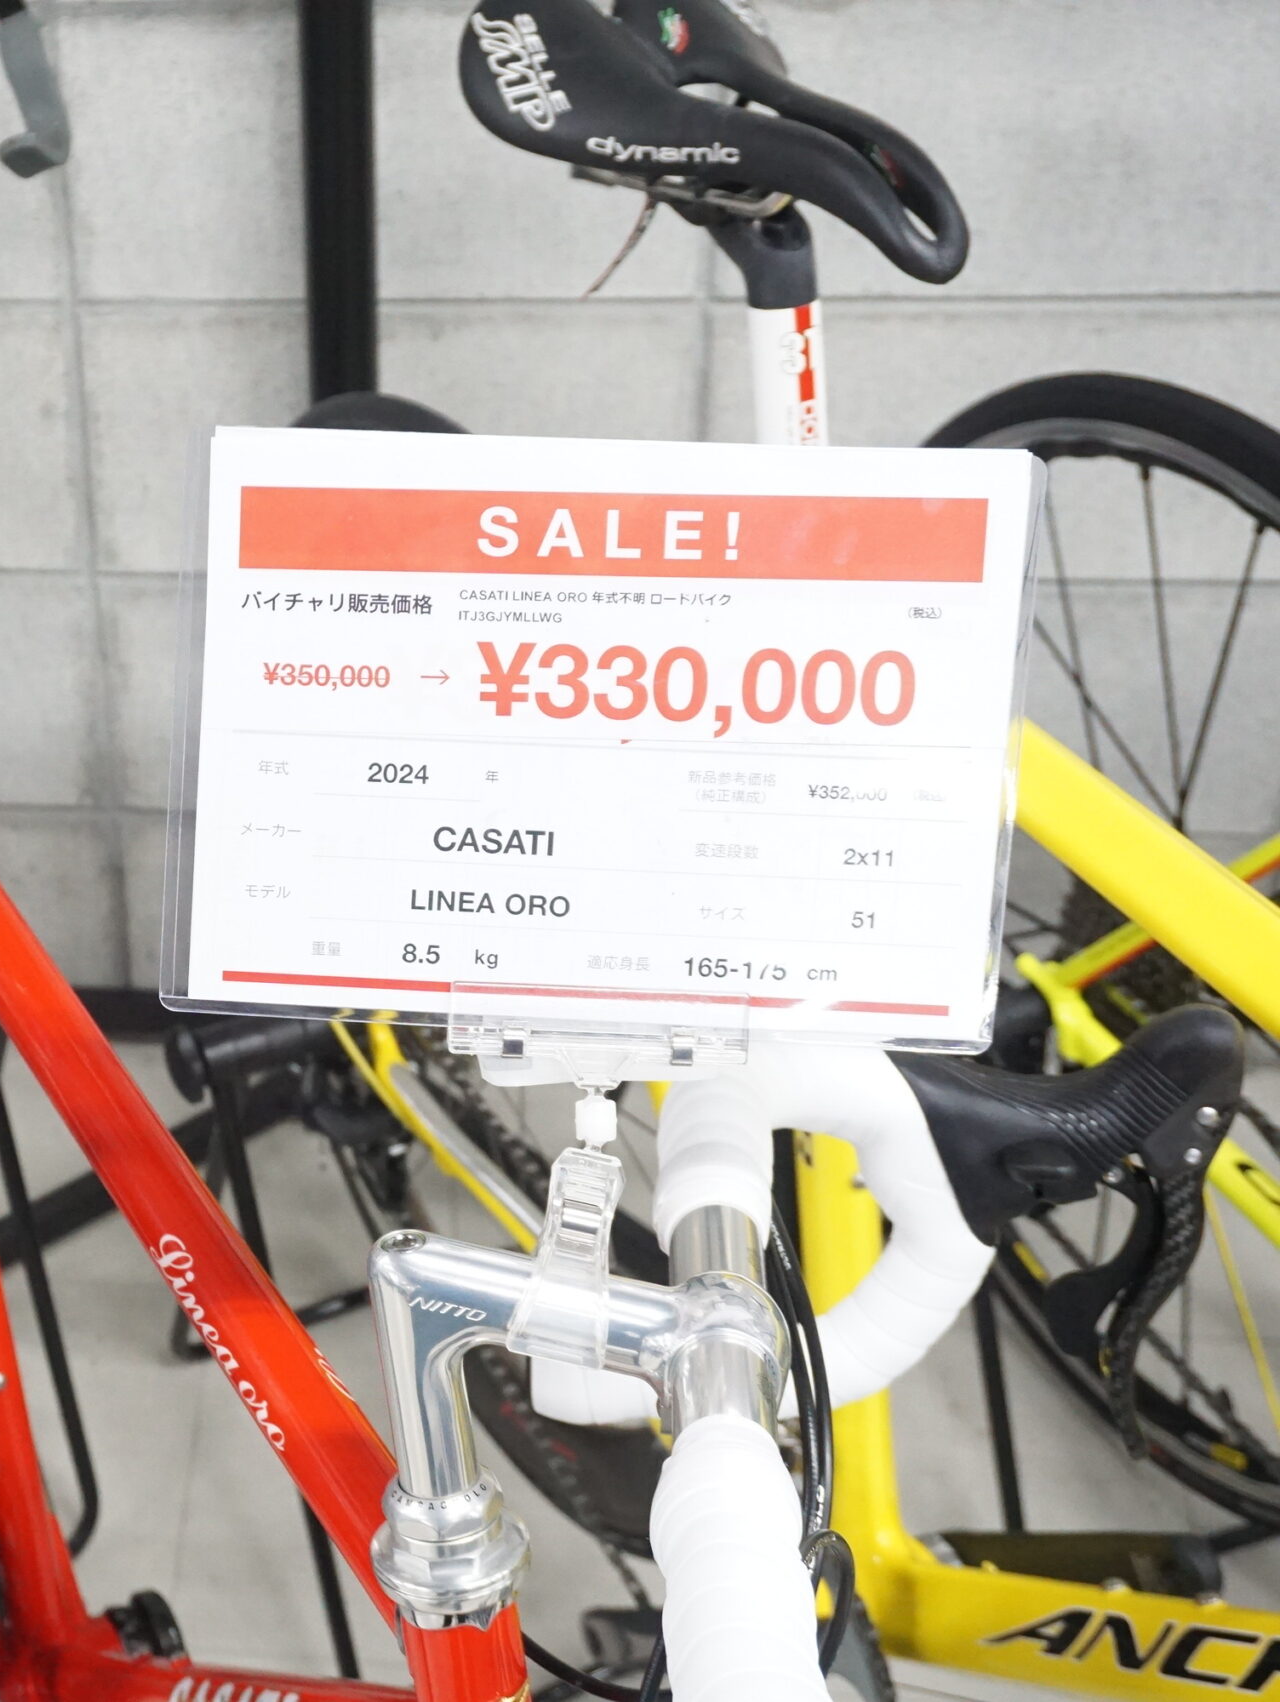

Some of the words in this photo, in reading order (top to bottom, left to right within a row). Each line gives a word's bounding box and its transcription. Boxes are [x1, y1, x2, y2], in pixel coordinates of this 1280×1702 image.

[513, 13, 572, 114] SELLE
[586, 135, 741, 165] dynamic
[477, 506, 742, 561] SALE!
[241, 590, 433, 616] バイチャリ販売価格
[458, 589, 509, 602] CASATI
[511, 590, 552, 602] LINEA
[556, 591, 588, 603] ORO
[591, 591, 646, 605] 年式不明
[650, 592, 732, 606] ロードバイク
[263, 661, 391, 691] ¥350,000
[476, 640, 917, 738] ¥330,000
[258, 759, 289, 776] 年式
[367, 763, 429, 785] 2024
[485, 770, 499, 784] 年
[240, 822, 302, 839] メーカー
[433, 826, 555, 857] CASATI
[843, 848, 895, 868] 2x11
[245, 884, 291, 900] モデル
[410, 889, 496, 914] LINEA
[505, 893, 571, 918] ORO
[851, 911, 877, 930] 51
[402, 943, 441, 965] 8.5
[474, 949, 499, 969] kg
[807, 966, 838, 982] cm
[408, 1296, 488, 1322] NITTO
